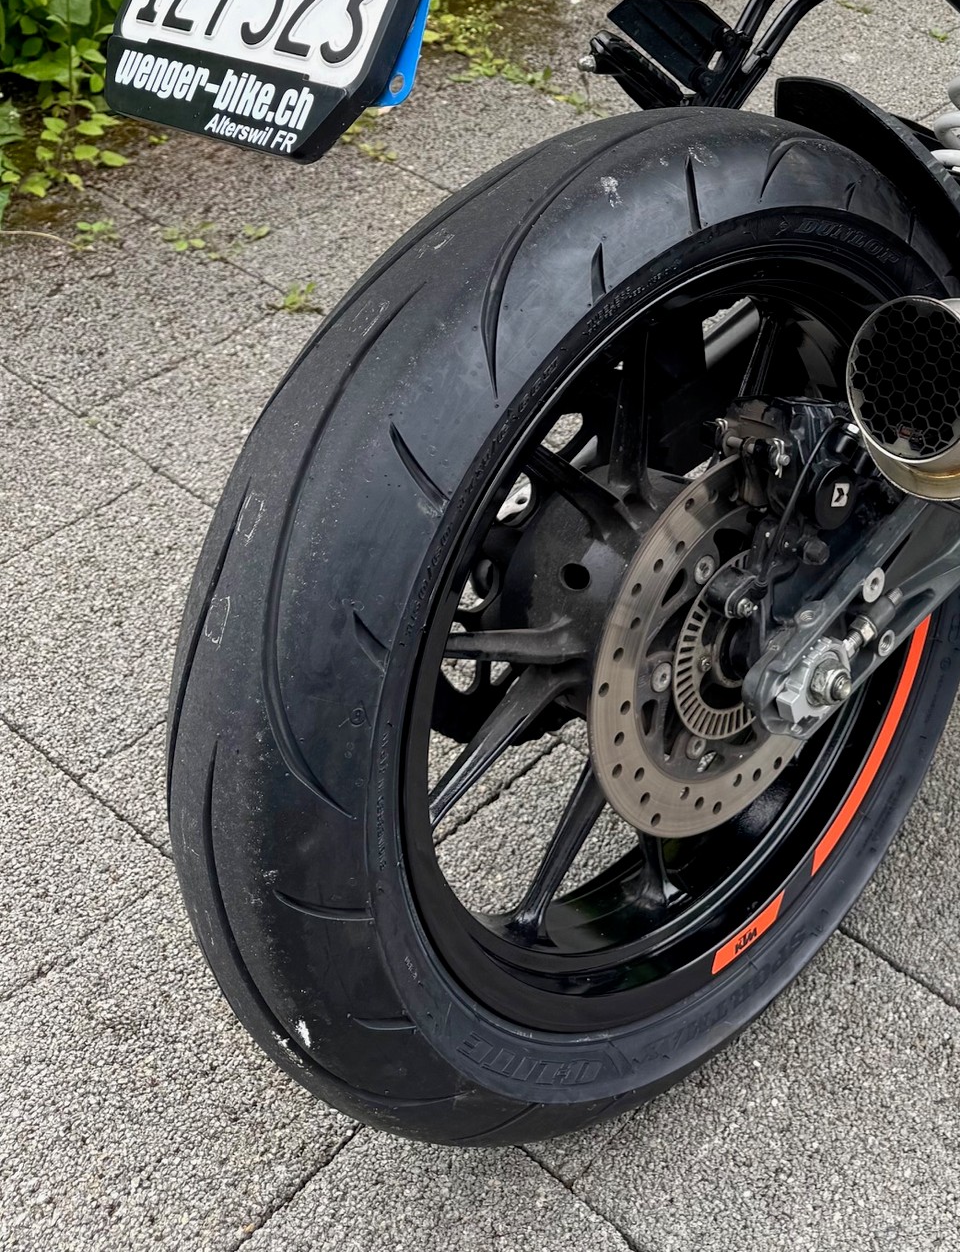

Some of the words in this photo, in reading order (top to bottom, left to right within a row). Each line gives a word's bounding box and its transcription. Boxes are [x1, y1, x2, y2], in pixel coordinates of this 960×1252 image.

[114, 49, 315, 130] wenger-bike.ch
[204, 113, 273, 147] Alterswil
[270, 130, 298, 153] FR
[794, 217, 900, 264] DUNLOP
[734, 927, 758, 955] KTM
